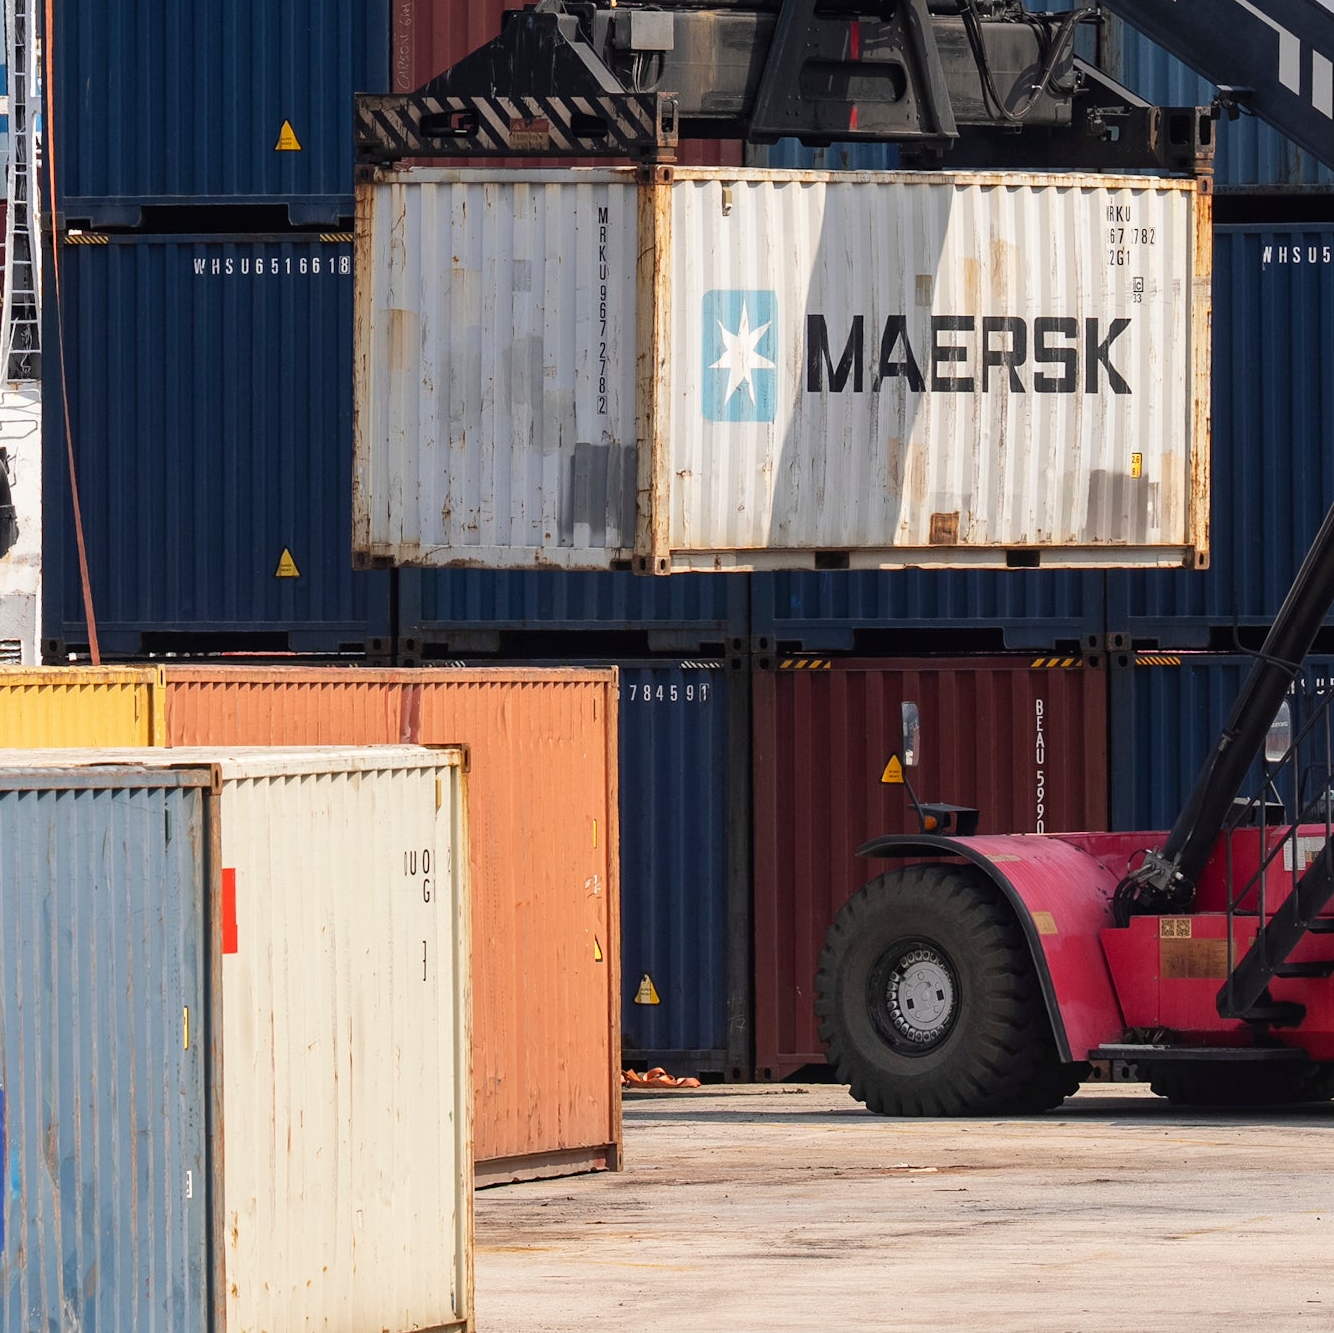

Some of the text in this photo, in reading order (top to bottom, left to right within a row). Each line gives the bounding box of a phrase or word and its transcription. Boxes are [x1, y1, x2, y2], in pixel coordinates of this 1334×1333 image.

[194, 256, 350, 274] WHSU6516618
[599, 207, 608, 280] MRKU
[807, 314, 1131, 394] MAERSK
[1036, 700, 1044, 764] BEAU
